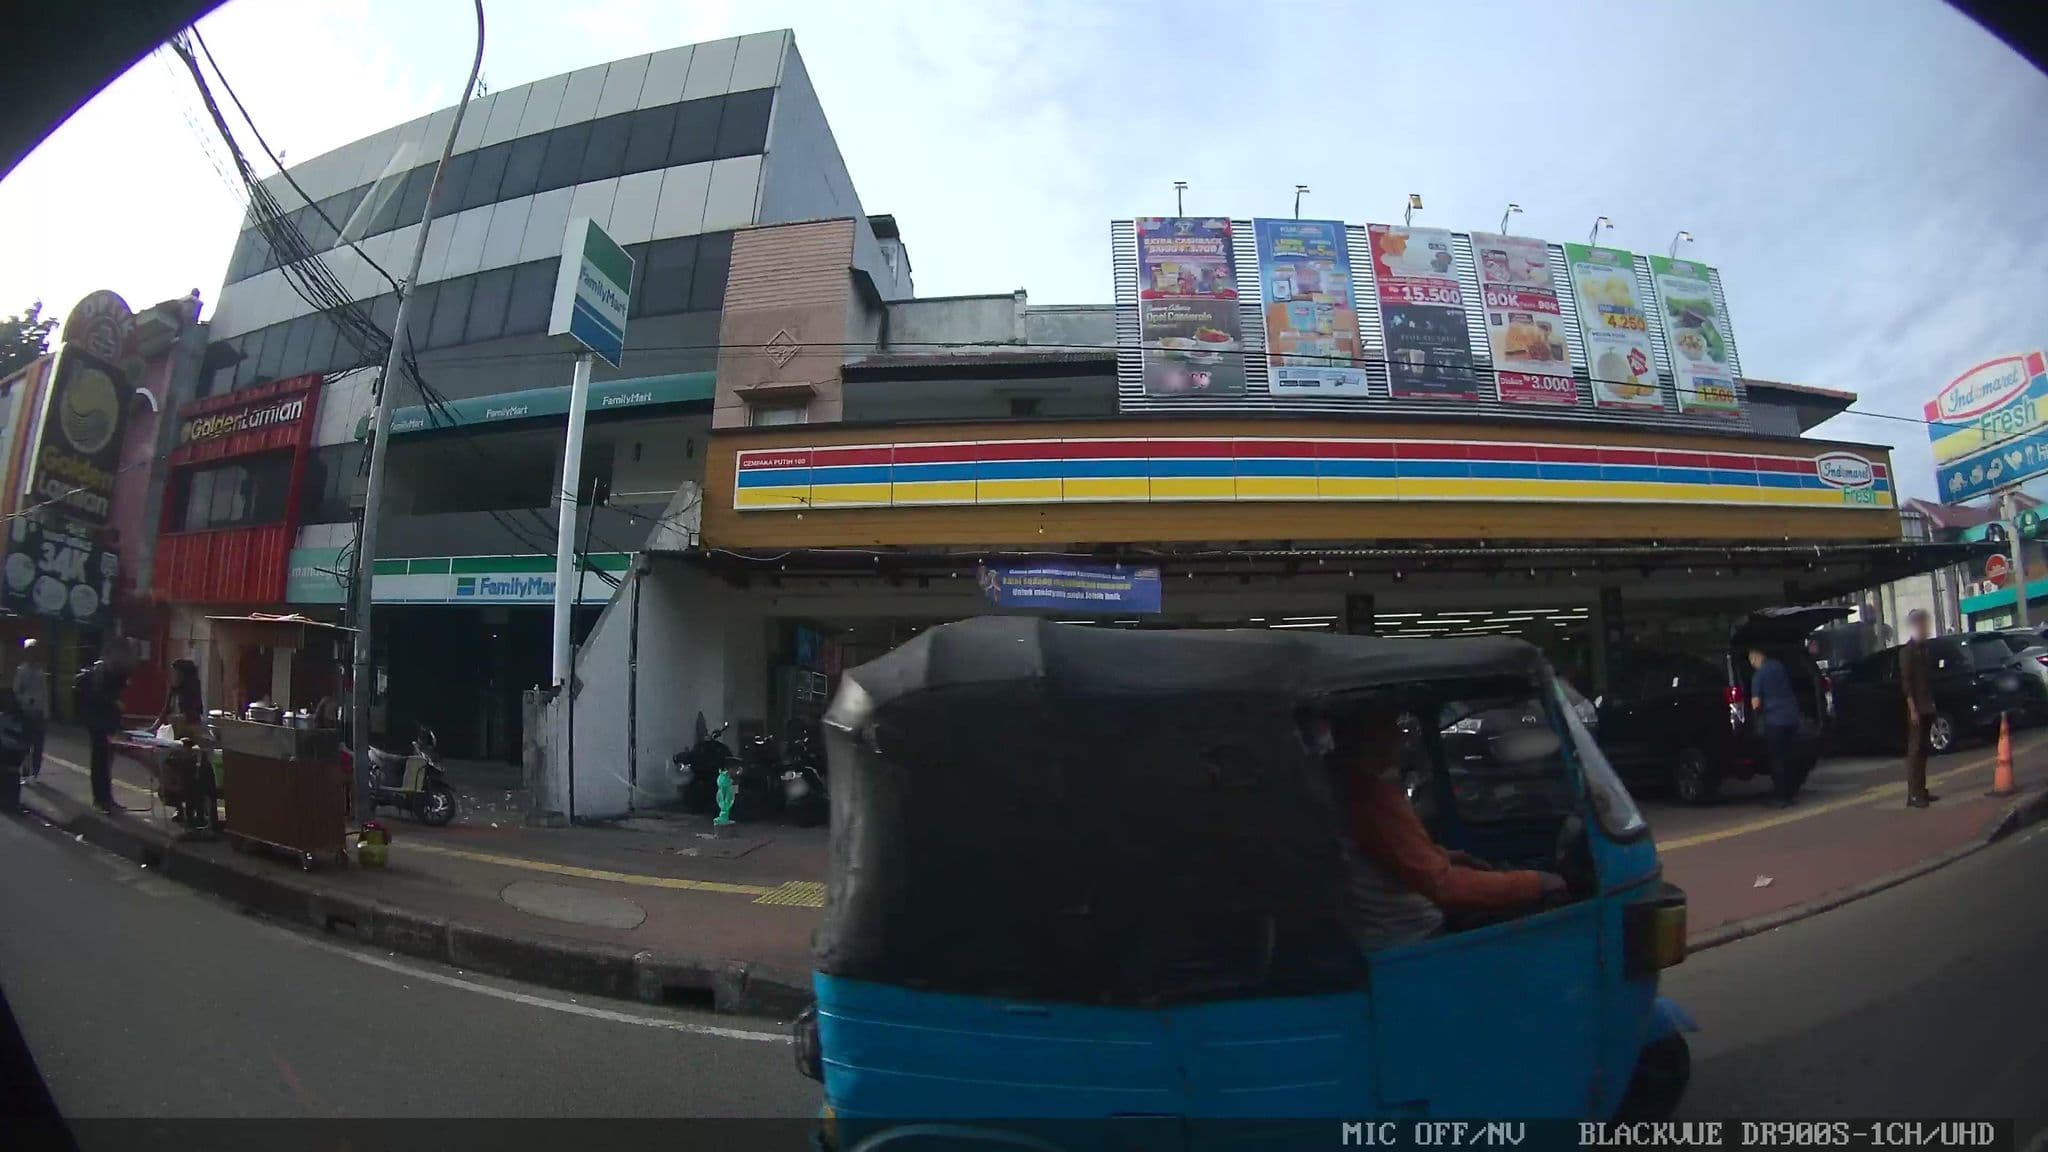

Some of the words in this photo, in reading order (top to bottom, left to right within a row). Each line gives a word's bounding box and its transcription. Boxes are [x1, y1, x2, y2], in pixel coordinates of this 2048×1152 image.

[579, 265, 627, 319] FamilyMart
[1402, 287, 1460, 304] 15.500
[1531, 375, 1569, 392] 3.000
[1948, 367, 2019, 412] Indomaret
[602, 392, 653, 406] FamilyMart
[486, 405, 529, 418] FamilyMart
[1980, 396, 2037, 440] Fresh
[1823, 462, 1869, 479] Indomaret
[1843, 484, 1876, 504] Fresh
[480, 577, 557, 598] FamilyMar
